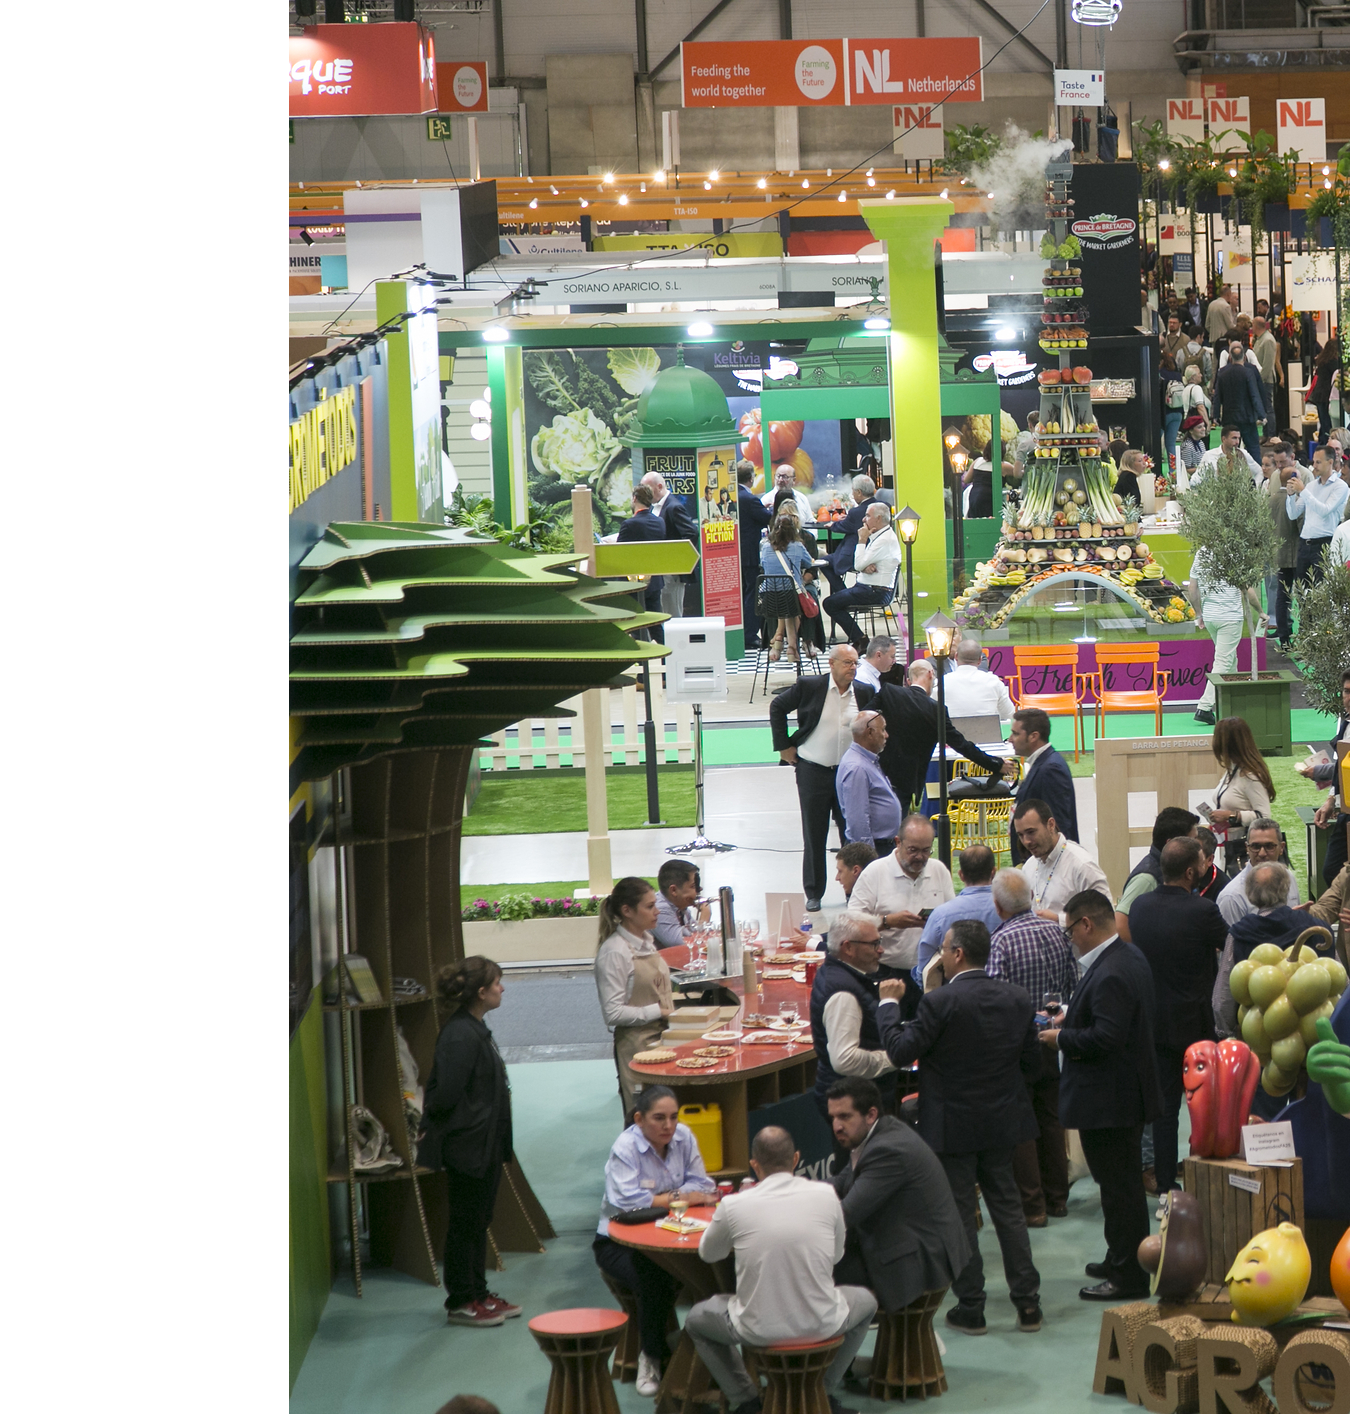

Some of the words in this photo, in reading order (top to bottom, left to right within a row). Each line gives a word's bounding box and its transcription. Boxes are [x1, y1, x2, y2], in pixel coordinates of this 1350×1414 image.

[802, 59, 830, 70] Farming
[855, 49, 903, 93] NL
[908, 75, 975, 93] Netherlands
[691, 65, 731, 79] Feeding
[733, 65, 750, 76] the
[802, 69, 813, 77] the
[802, 78, 824, 86] Future
[1060, 81, 1085, 90] Taste
[318, 84, 351, 95] PORT
[691, 85, 720, 97] world
[722, 85, 766, 99] together
[1060, 89, 1090, 99] France
[1169, 100, 1202, 120] NL
[1211, 100, 1248, 122] NL
[1280, 101, 1323, 127] NL
[904, 106, 941, 129] NL
[1102, 222, 1133, 230] BRETAGNE
[1107, 235, 1134, 250] GARDENERS
[563, 283, 610, 293] SORIANO
[612, 281, 662, 293] APARICIO,
[666, 281, 682, 291] S.L.
[832, 276, 876, 286] SORIAN
[714, 352, 761, 364] Keltivia
[646, 455, 695, 471] FRUIT
[664, 478, 695, 495] ARS
[704, 520, 735, 533] POMMES
[706, 530, 735, 544] FICTION
[1132, 740, 1159, 749] BARRA
[1160, 740, 1171, 748] DE
[1173, 738, 1210, 748] PETANCA
